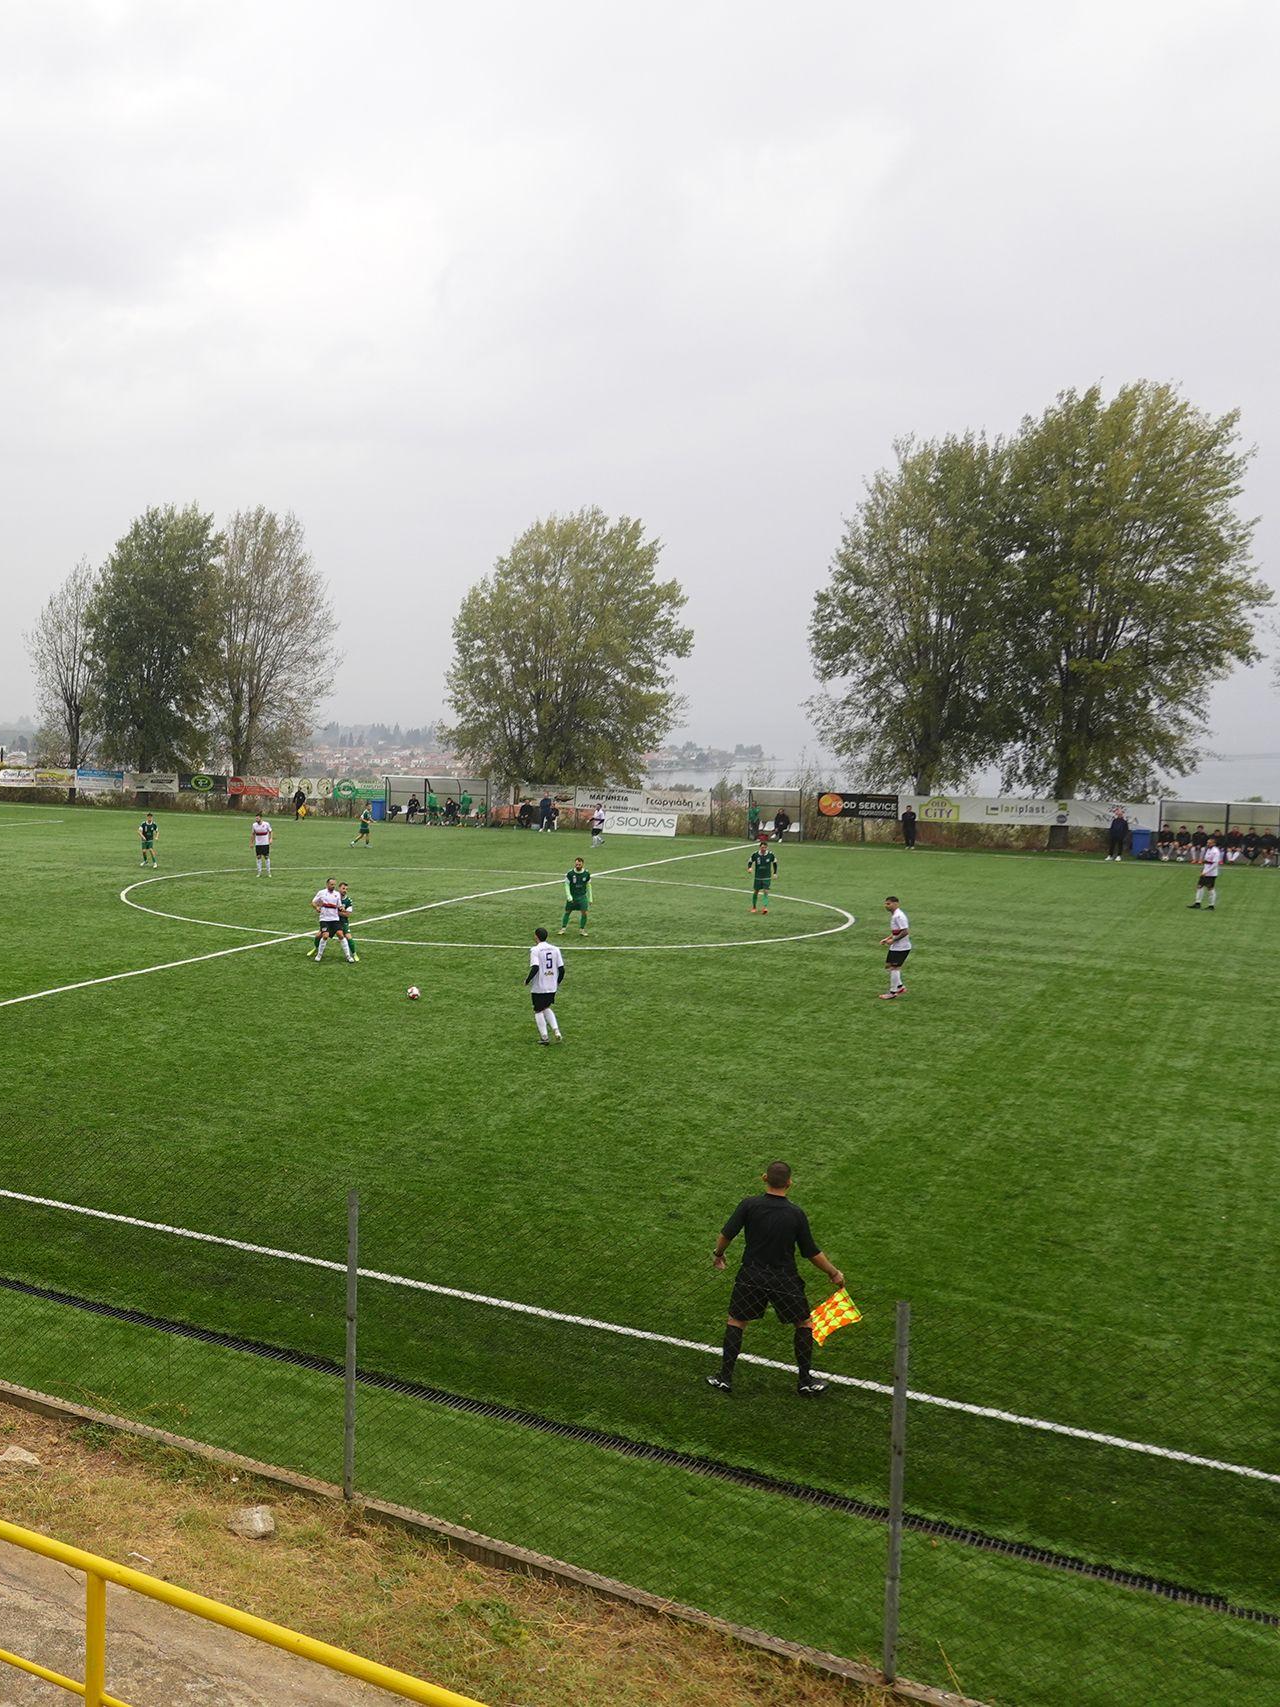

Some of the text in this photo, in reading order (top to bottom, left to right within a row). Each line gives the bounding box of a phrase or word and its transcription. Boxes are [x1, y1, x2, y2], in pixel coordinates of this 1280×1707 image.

[589, 794, 629, 802] ΜΑΓΝΗΣΙΑ
[831, 801, 897, 811] FOOD SERVICE
[1000, 804, 1046, 815] lariplast
[616, 816, 675, 829] SIOURAS
[546, 952, 553, 969] 5
